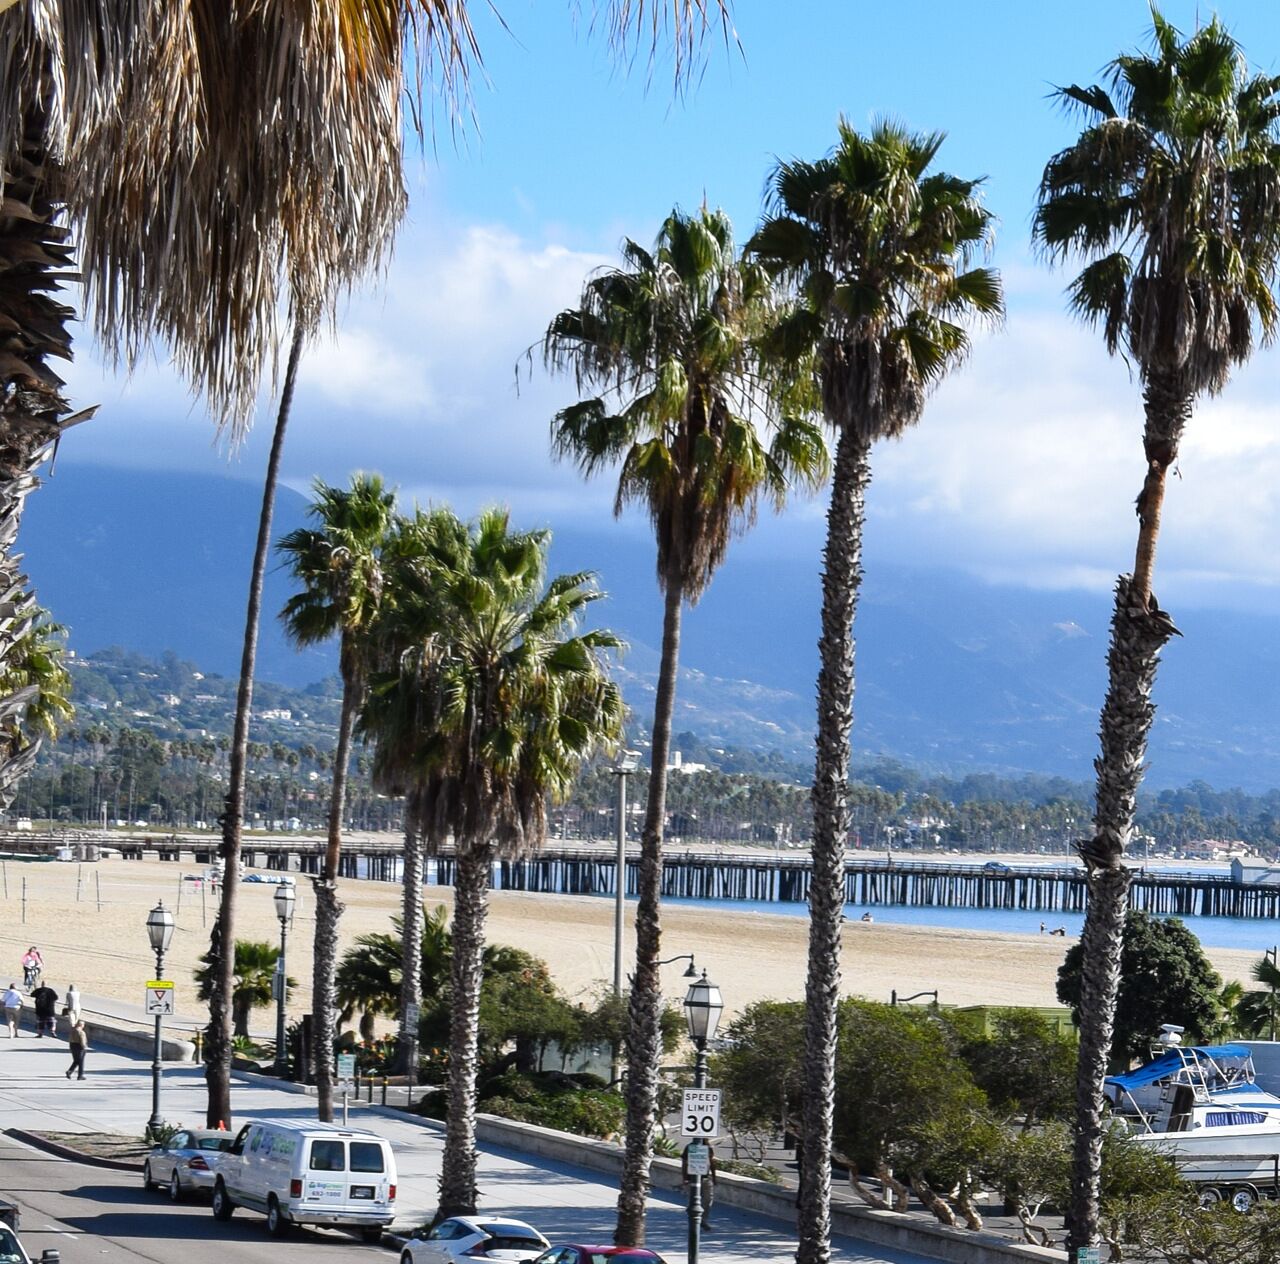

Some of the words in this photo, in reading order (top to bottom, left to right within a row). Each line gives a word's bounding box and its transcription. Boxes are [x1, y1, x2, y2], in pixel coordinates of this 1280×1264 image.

[685, 1093, 718, 1102] SPEED
[687, 1104, 715, 1112] LIMIT
[685, 1115, 714, 1133] 30
